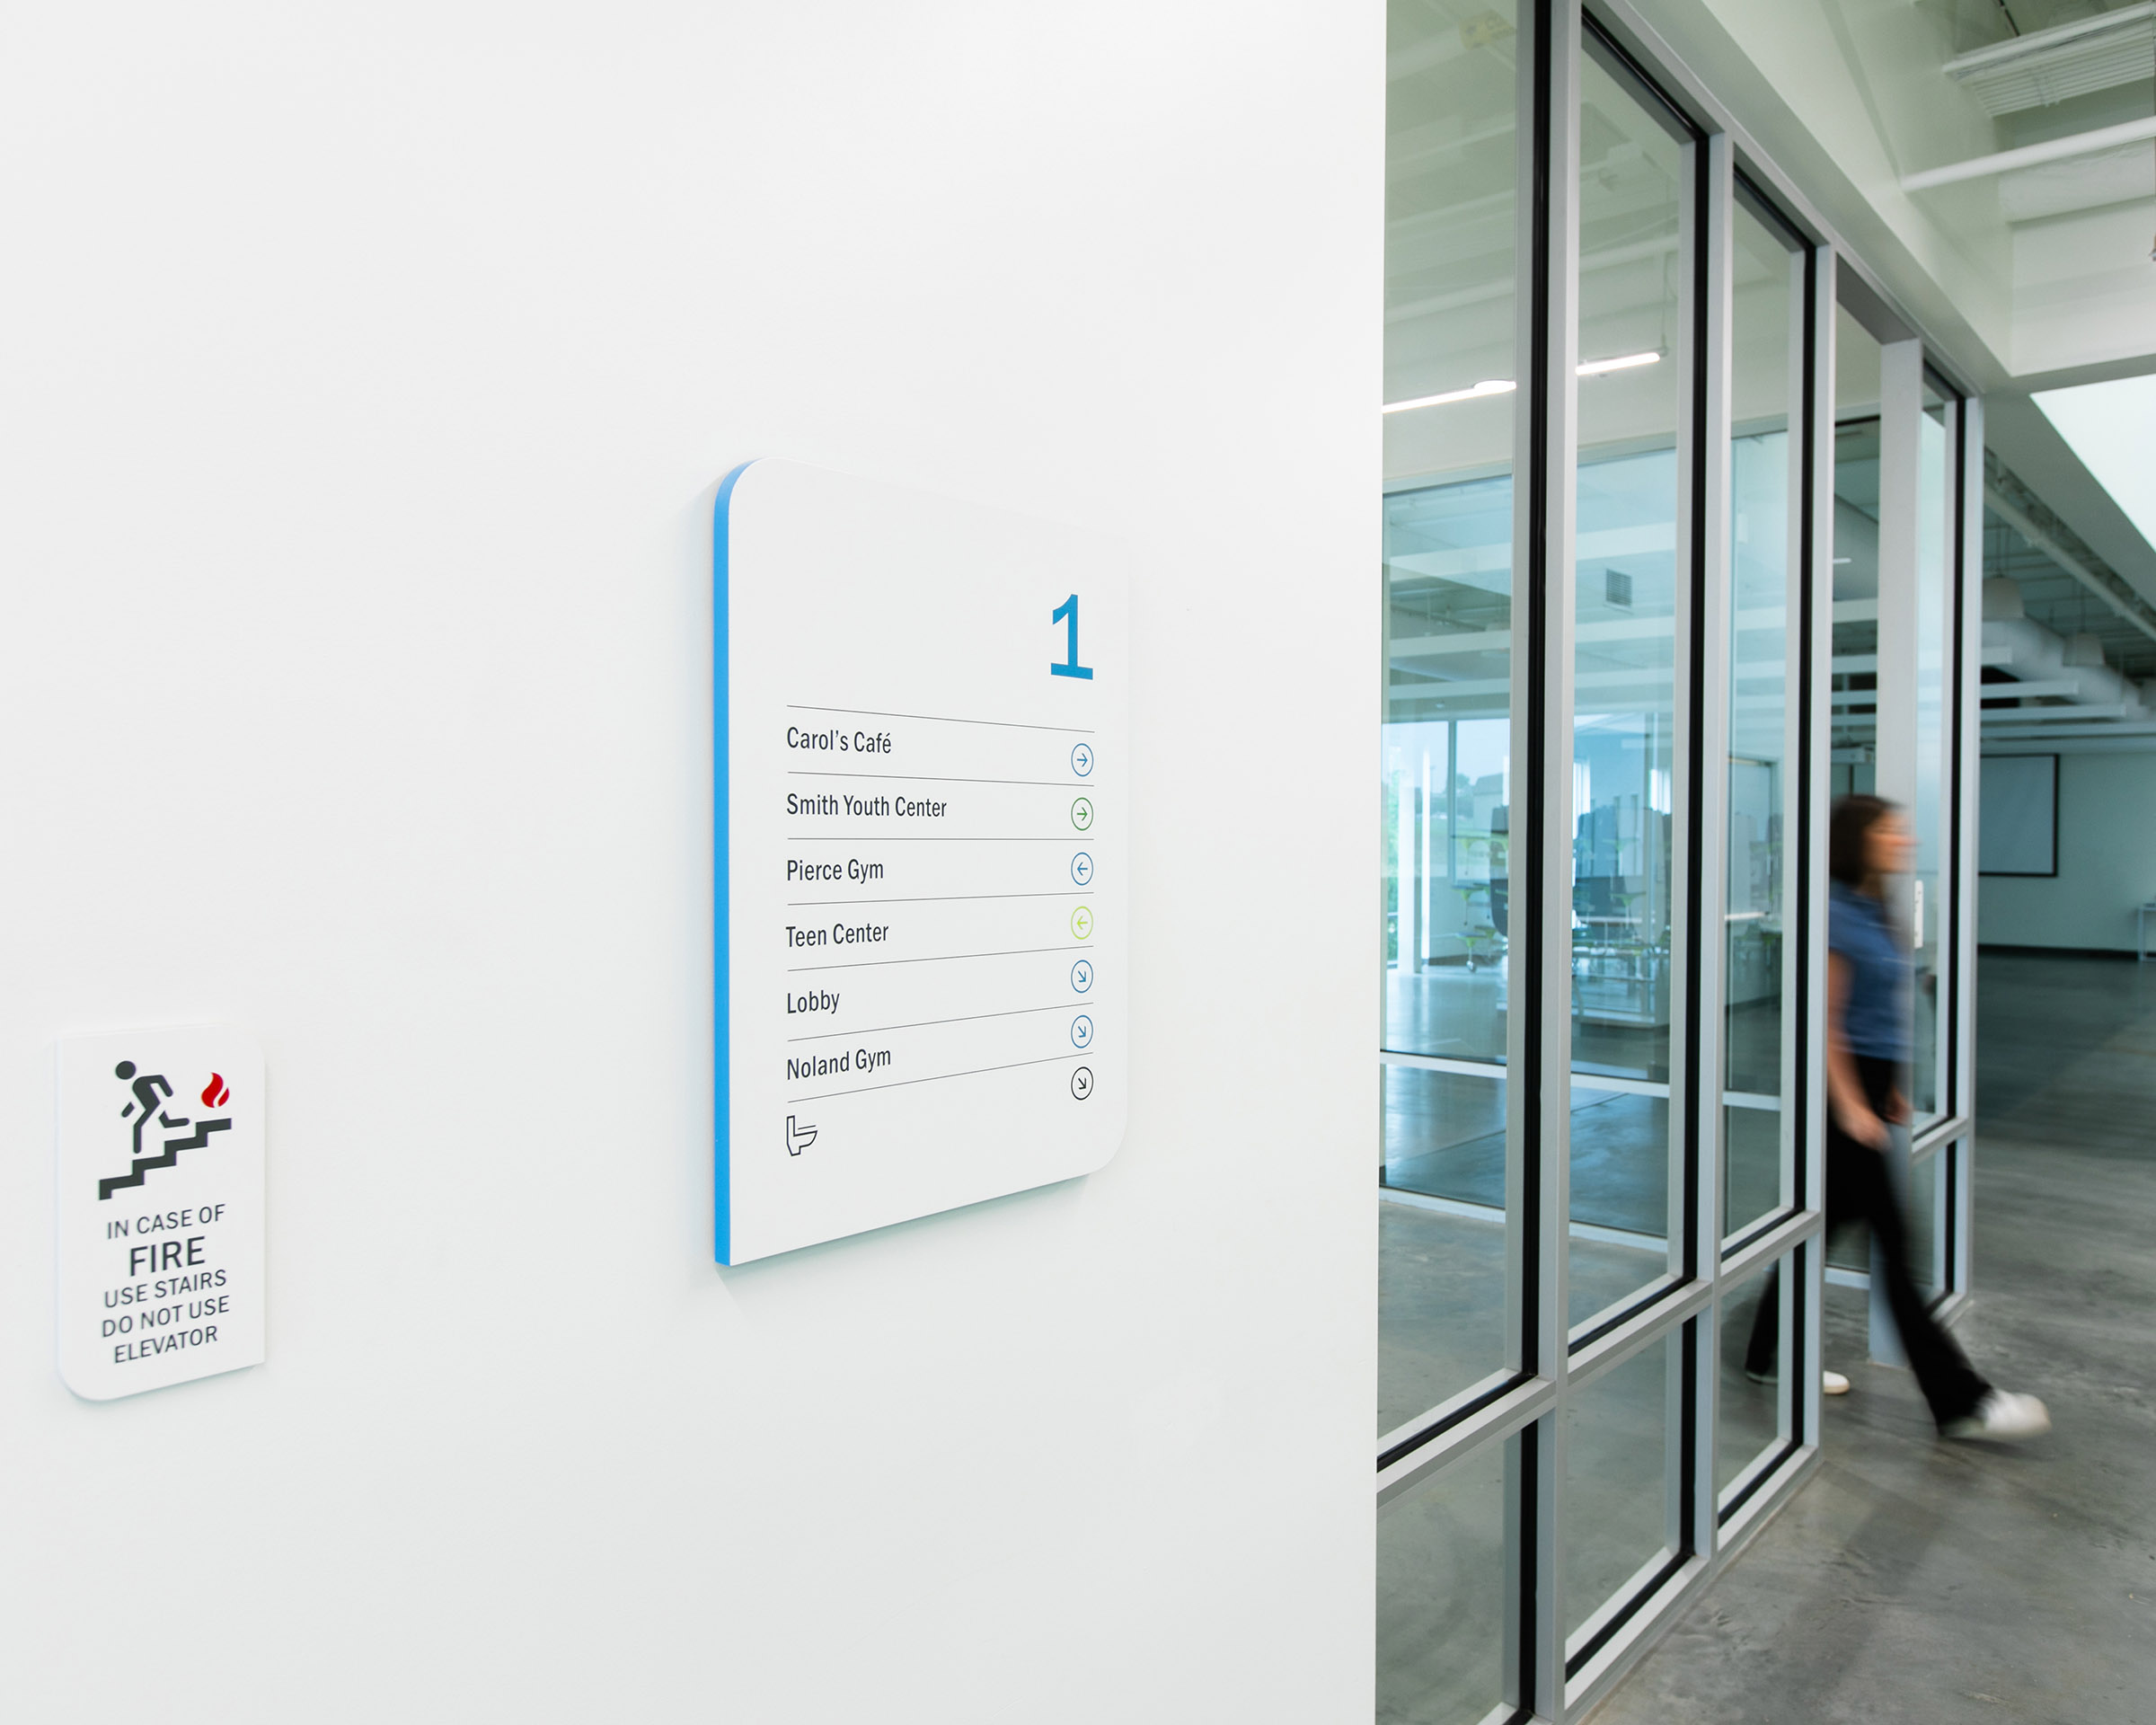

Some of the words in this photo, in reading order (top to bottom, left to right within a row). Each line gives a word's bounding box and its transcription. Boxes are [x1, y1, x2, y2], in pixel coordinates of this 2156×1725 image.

[1051, 593, 1094, 681] 1
[787, 727, 848, 752] Carol’s
[854, 730, 891, 754] Café
[787, 793, 839, 816] Smith
[844, 795, 889, 817] Youth
[896, 796, 948, 818] Center
[787, 860, 842, 881] Pierce
[848, 859, 884, 884] Gym
[786, 926, 826, 948] Teen
[833, 924, 888, 944] Center
[787, 990, 840, 1014] Lobby
[787, 1051, 850, 1080] Noland
[855, 1048, 891, 1074] Gym
[107, 1220, 128, 1240] IN
[137, 1209, 193, 1234] CASE
[199, 1204, 225, 1224] OF
[129, 1236, 206, 1277] FIRE
[104, 1284, 148, 1308] USE
[155, 1269, 227, 1299] STAIRS
[102, 1315, 133, 1338] DO
[141, 1305, 183, 1330] NOT
[189, 1296, 230, 1319] USE
[114, 1326, 217, 1364] ELEVATOR
